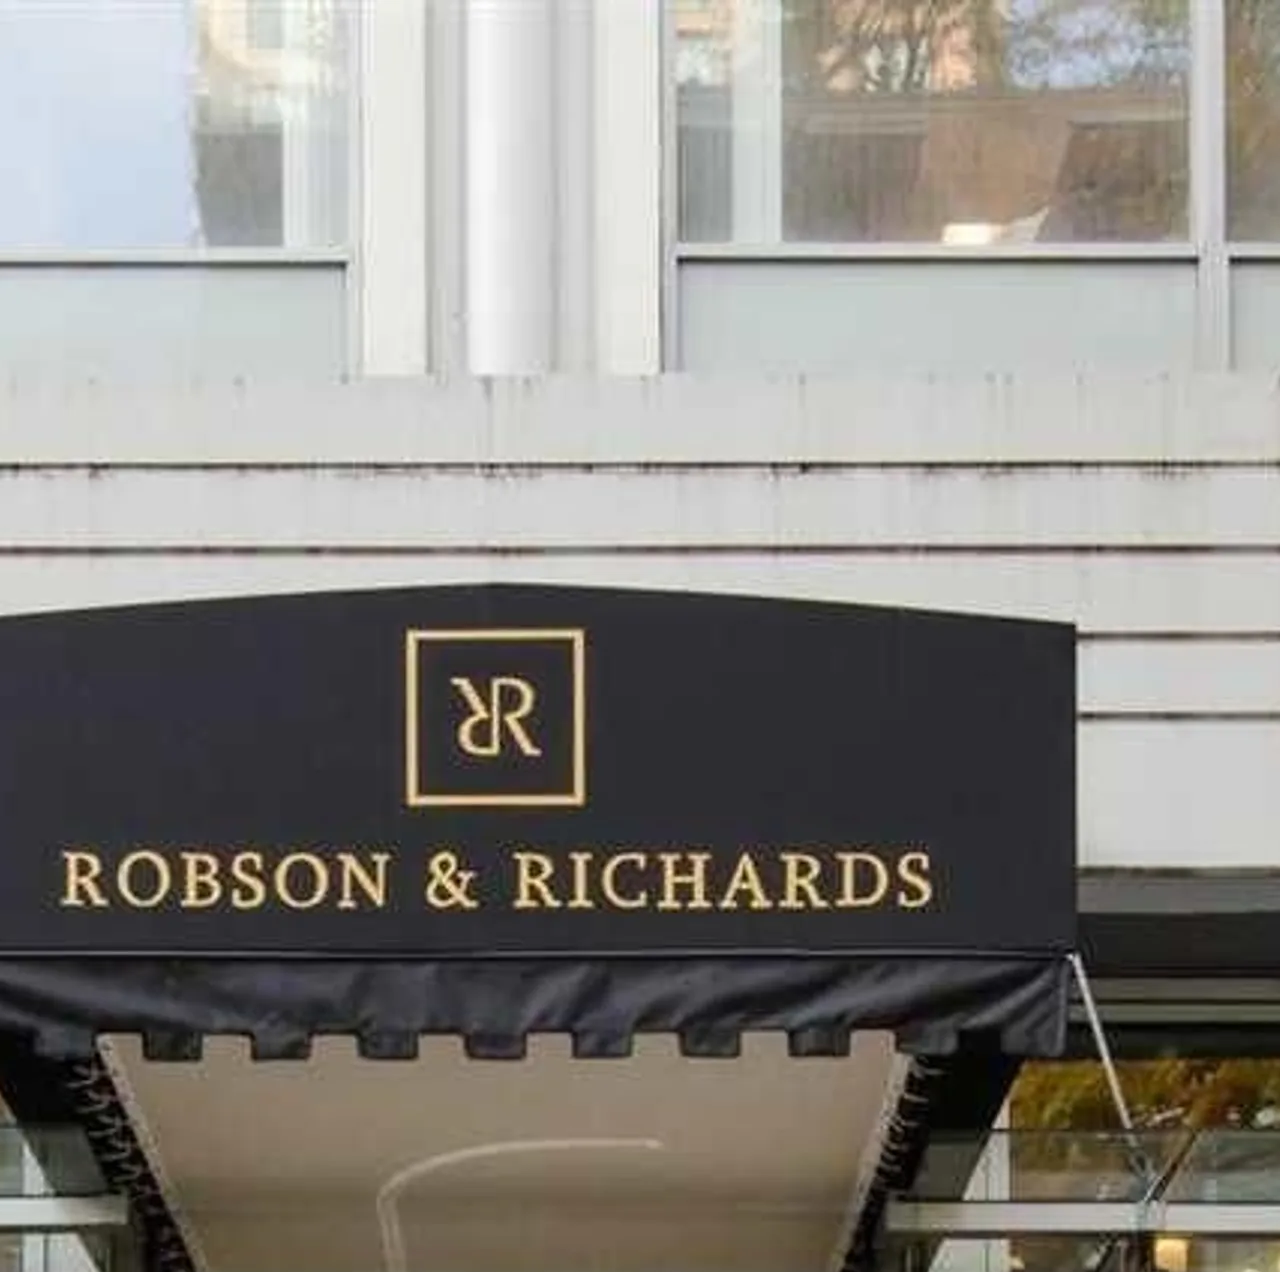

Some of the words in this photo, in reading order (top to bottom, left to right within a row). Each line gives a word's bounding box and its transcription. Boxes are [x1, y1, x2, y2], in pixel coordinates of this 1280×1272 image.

[60, 850, 392, 909] ROBSON
[426, 850, 480, 909] &
[512, 851, 934, 909] RICHARDS
